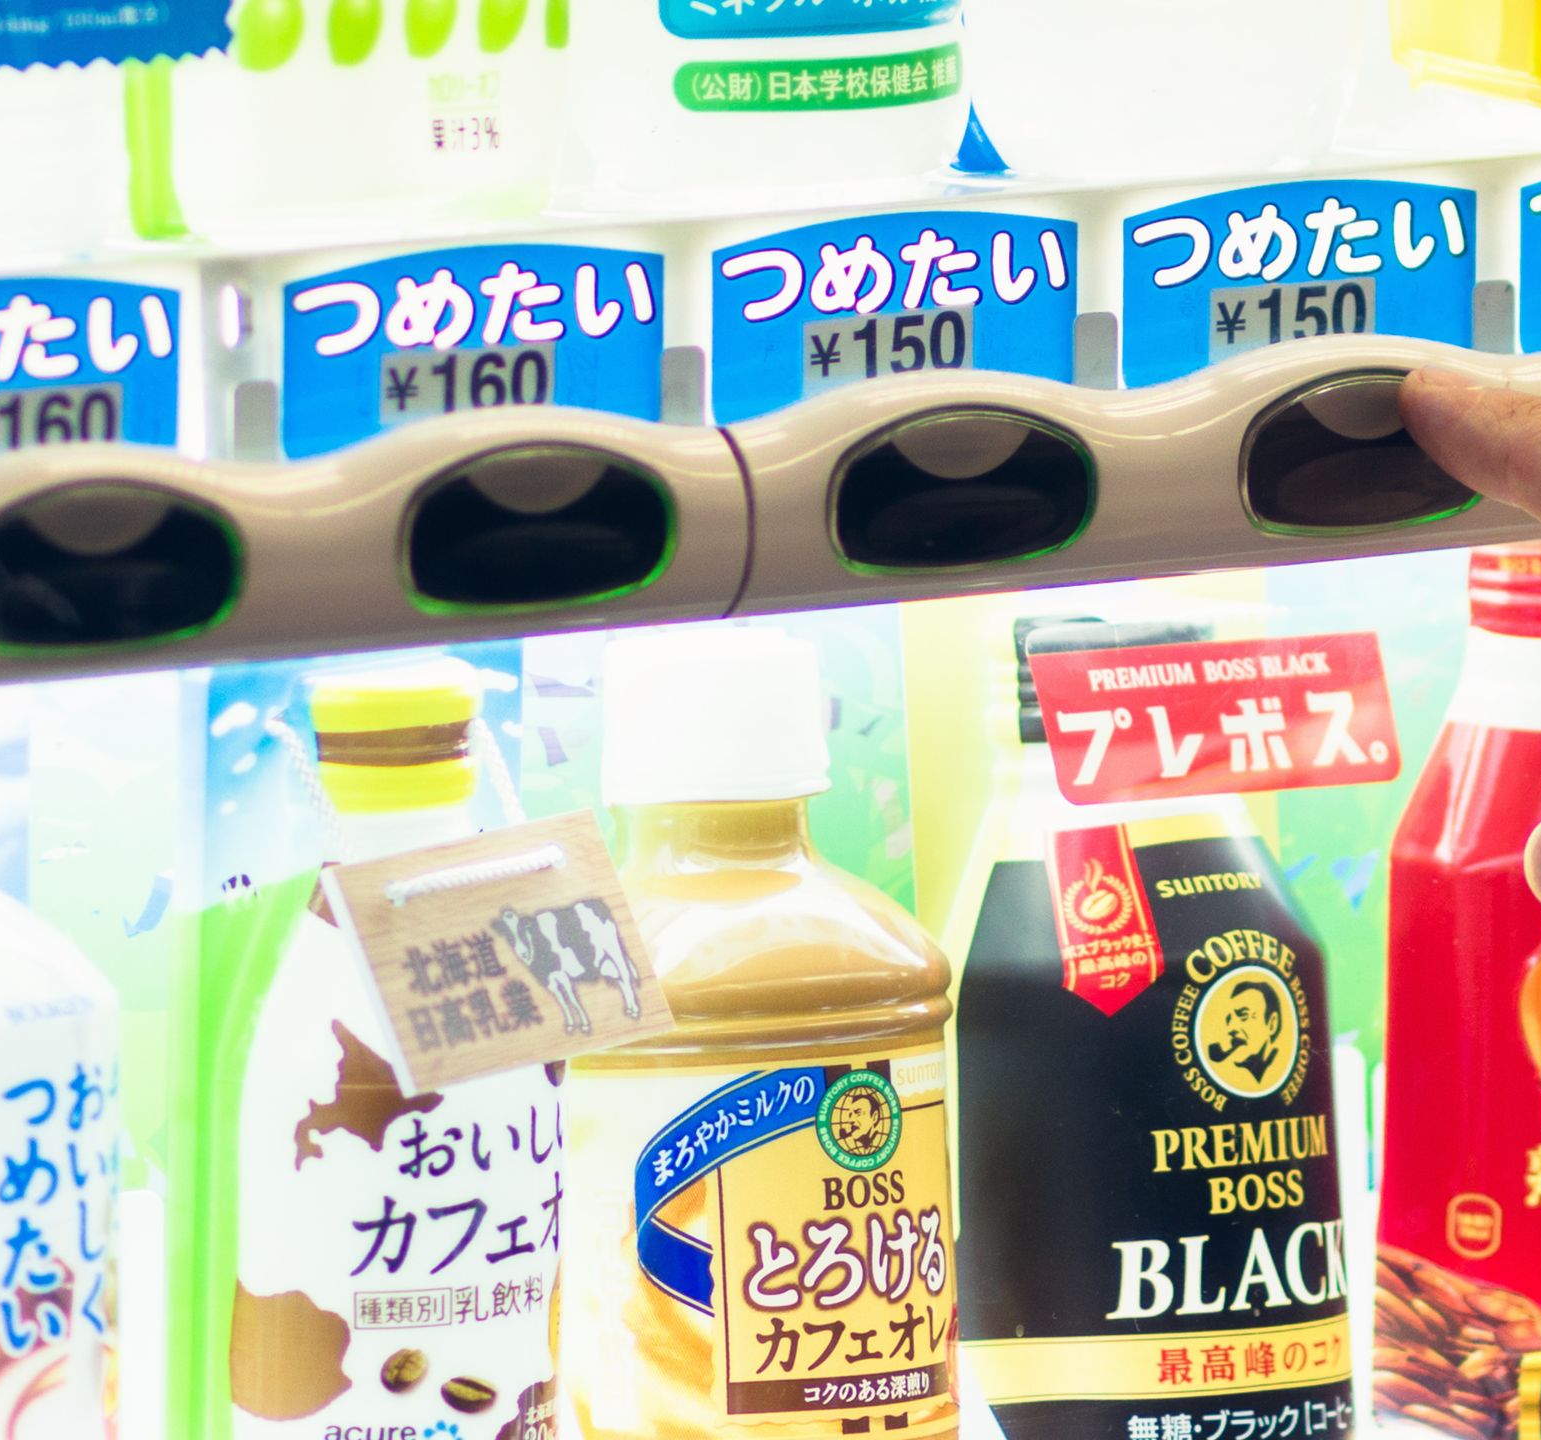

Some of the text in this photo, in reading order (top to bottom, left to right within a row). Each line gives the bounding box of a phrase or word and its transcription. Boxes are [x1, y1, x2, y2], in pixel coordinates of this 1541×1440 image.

[721, 227, 1068, 322] つめたい
[1132, 195, 1466, 290] つめたい
[292, 260, 655, 359] つめたい
[1215, 282, 1370, 346] ¥150
[386, 349, 550, 412] ¥160
[809, 310, 967, 382] ¥150
[1087, 651, 1332, 693] PREMIUM BOSS BLACK
[1055, 689, 1389, 787] プレボス。
[1155, 871, 1265, 899] SUNTORY
[403, 929, 508, 998] 北海道
[1099, 971, 1133, 989] コク
[1185, 928, 1297, 984] COFFEE
[405, 976, 545, 1054] 日高乳業
[1171, 983, 1229, 1113] BOSS COFFEE
[652, 1075, 816, 1187] まろやかミルクの
[1150, 1114, 1330, 1174] PREMIUM
[349, 1169, 565, 1277] カフェオ
[821, 1169, 906, 1212] BOSS
[1208, 1169, 1305, 1216] BOSS
[745, 1209, 947, 1310] とろける
[1105, 1218, 1349, 1321] BLACK
[359, 1294, 447, 1325] 種類別
[755, 1303, 948, 1375] カフェオレ
[802, 1372, 931, 1406] コクのある深煎り
[1157, 1334, 1343, 1386] 最高峰のコク
